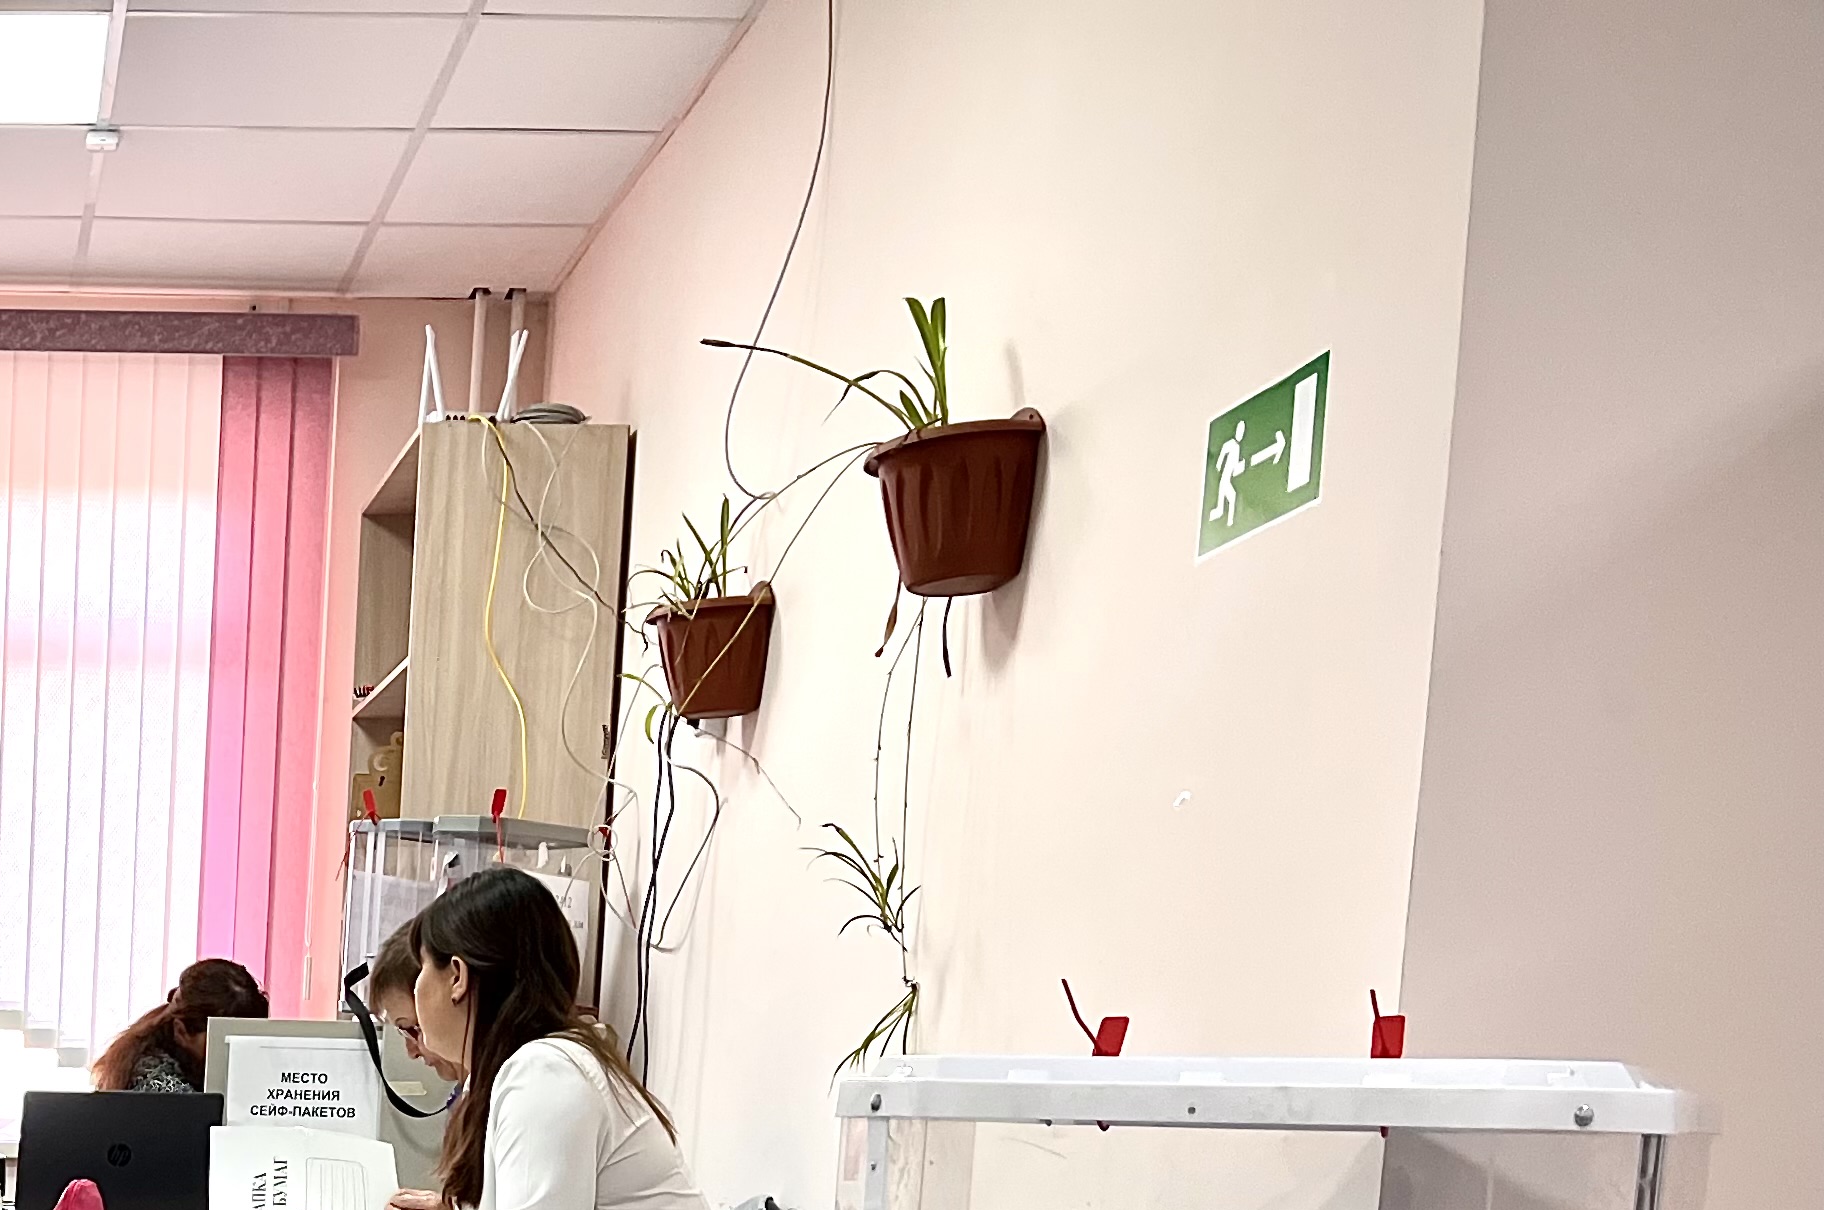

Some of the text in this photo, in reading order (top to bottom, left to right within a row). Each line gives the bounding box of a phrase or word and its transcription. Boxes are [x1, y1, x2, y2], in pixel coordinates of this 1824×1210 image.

[280, 1072, 328, 1084] МЕСТО
[266, 1089, 340, 1101] ХРАНЕНИЯ
[250, 1103, 356, 1118] СЕЙФ-ПАКЕТОВ
[108, 1143, 131, 1168] hp
[272, 1155, 288, 1206] БУМАГ
